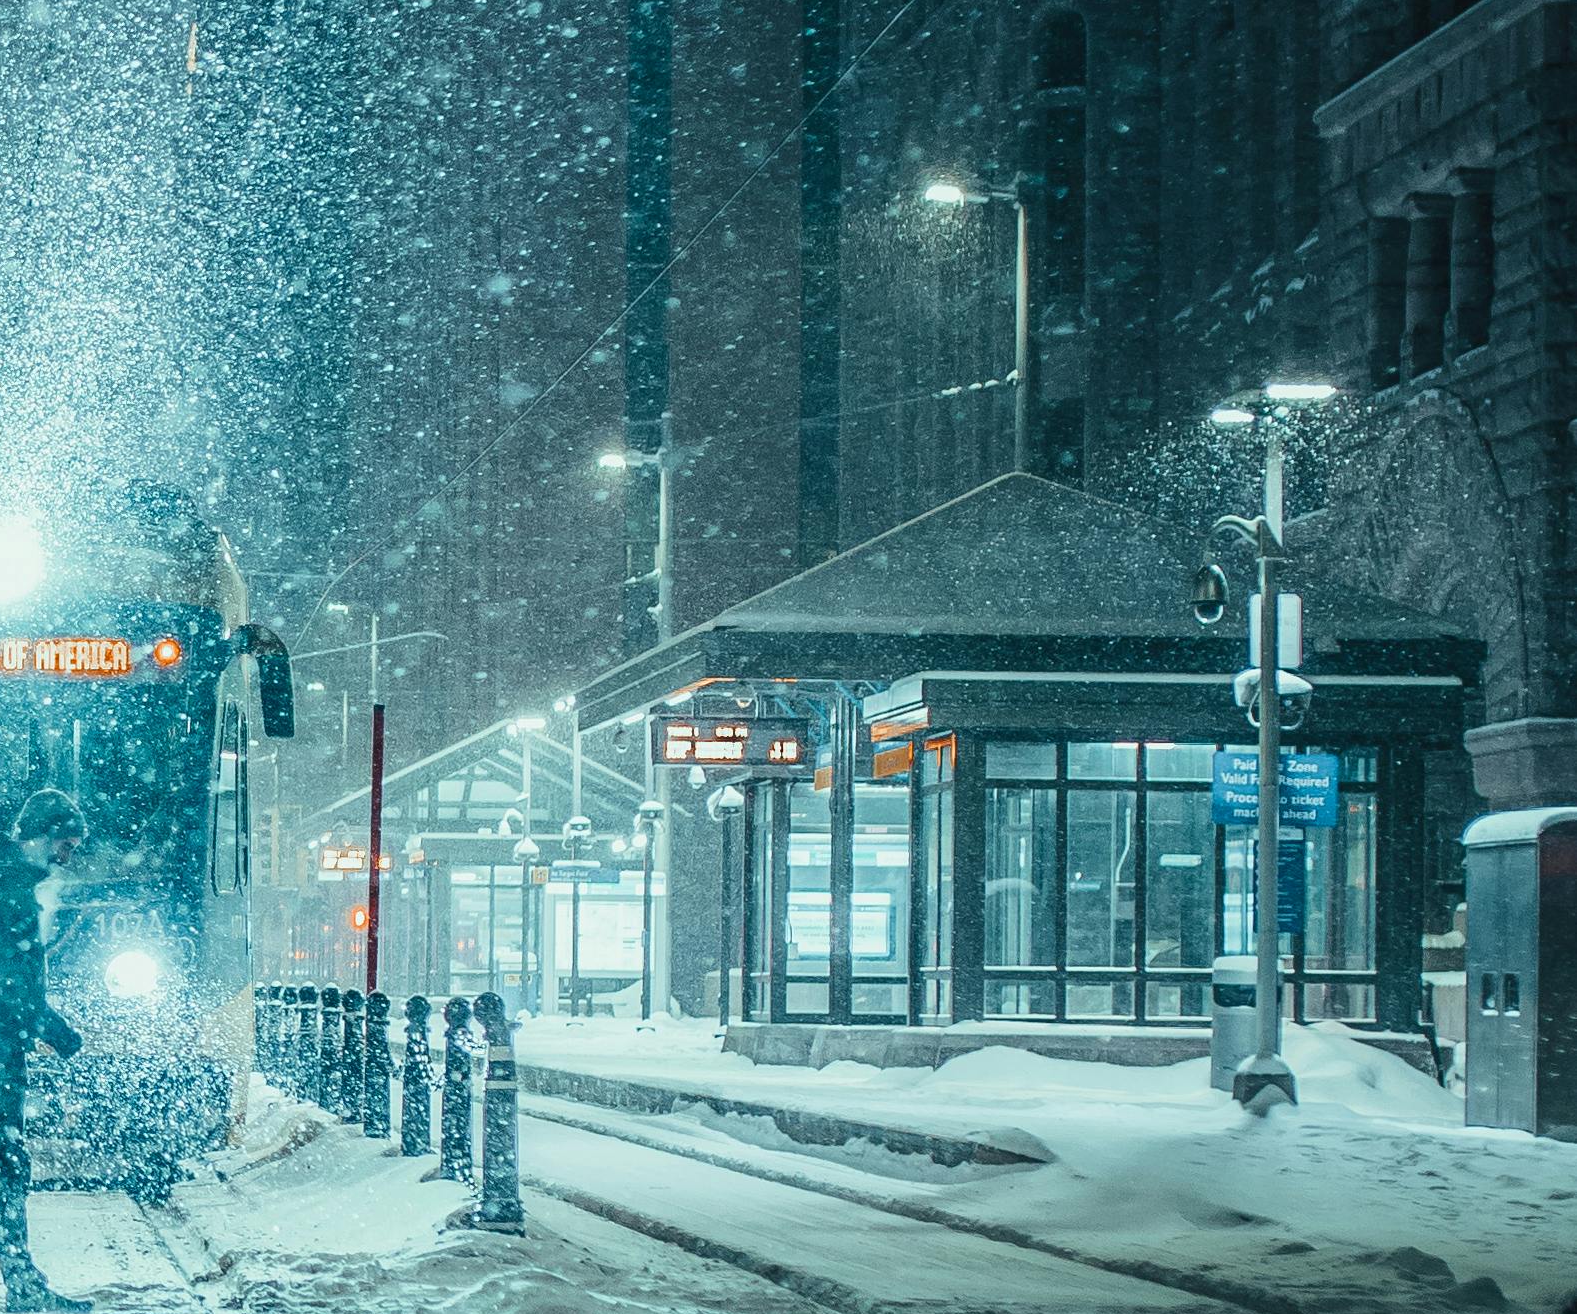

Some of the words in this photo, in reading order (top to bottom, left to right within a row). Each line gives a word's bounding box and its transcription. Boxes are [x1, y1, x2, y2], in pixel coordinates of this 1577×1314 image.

[2, 640, 28, 670] OF
[35, 640, 127, 671] AMERICA
[1233, 758, 1257, 771] Paid
[1287, 760, 1319, 773] Zone
[1221, 772, 1249, 785] Valid
[1278, 774, 1330, 790] Required
[1226, 791, 1258, 804] Proce
[1291, 793, 1326, 806] ticket
[1283, 809, 1317, 820] ahead
